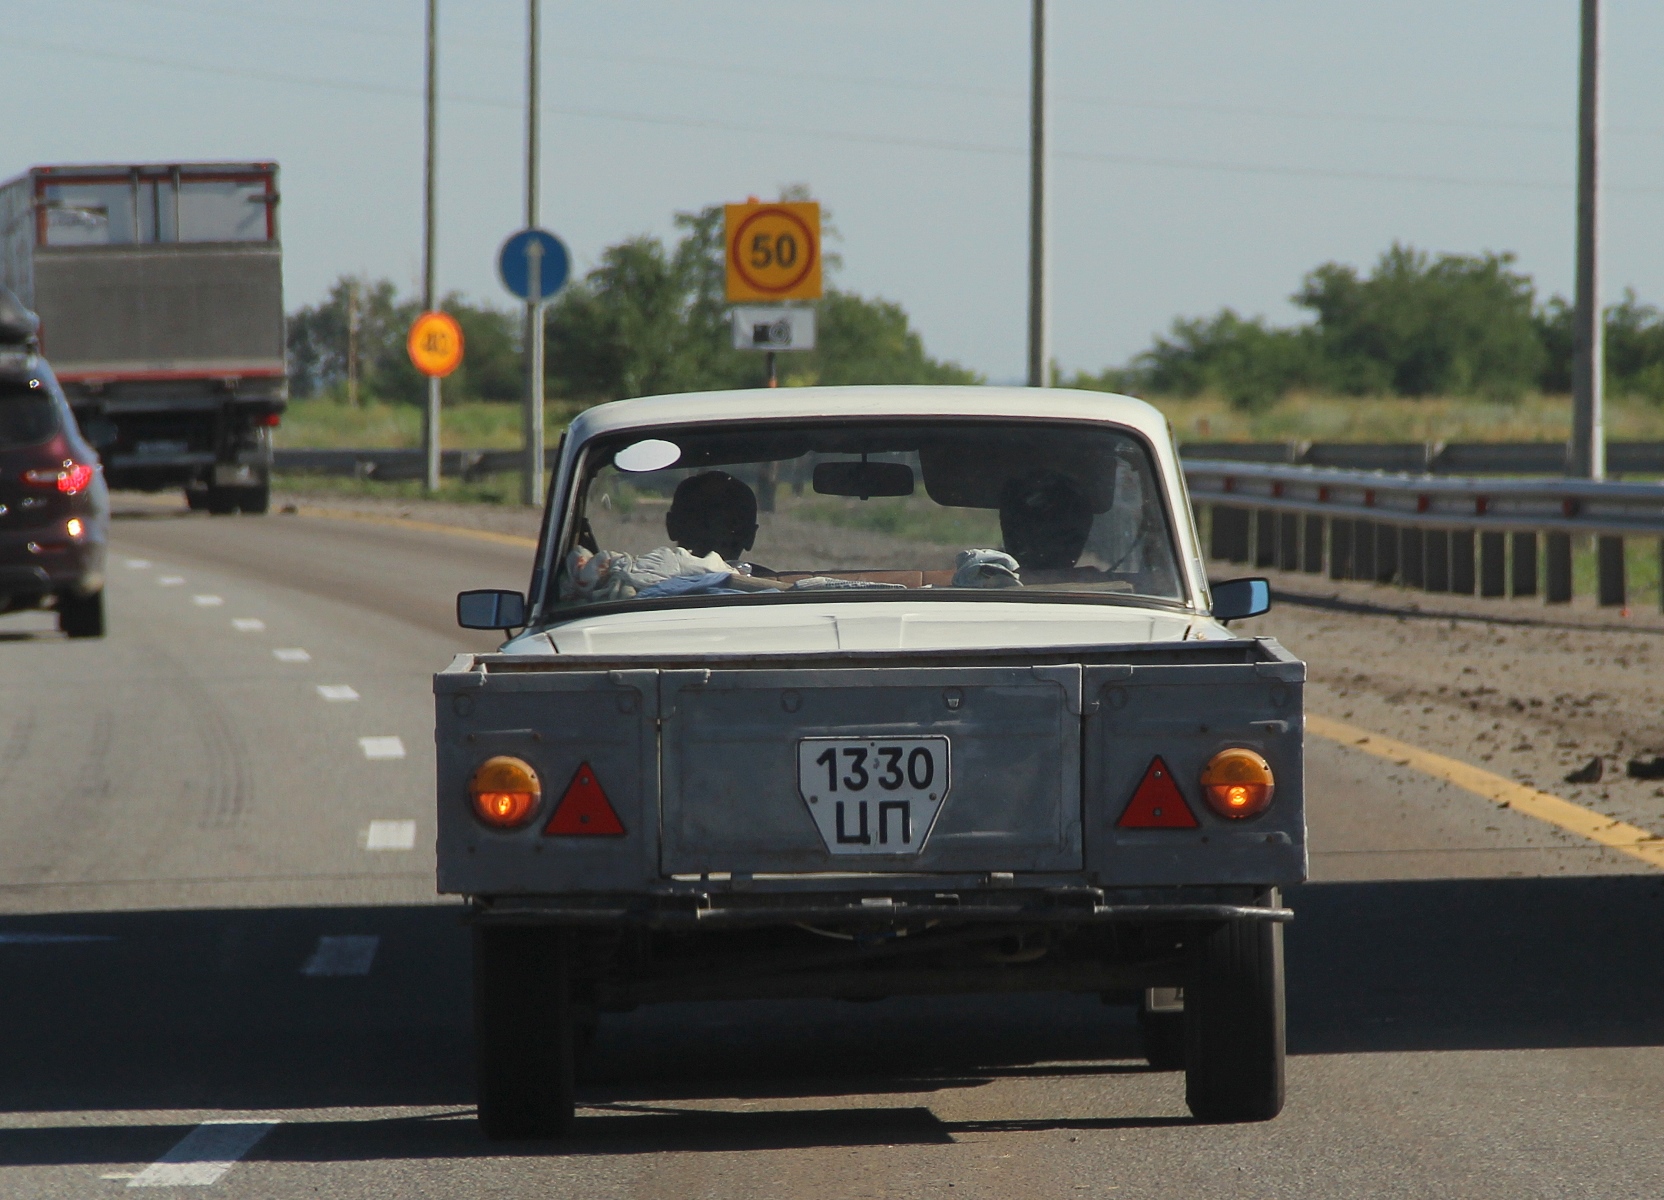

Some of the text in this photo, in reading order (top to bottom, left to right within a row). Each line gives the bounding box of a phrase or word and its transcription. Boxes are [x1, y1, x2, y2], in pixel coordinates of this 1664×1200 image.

[751, 233, 797, 269] 50
[816, 747, 934, 791] 1330
[836, 801, 911, 845] ЦП
